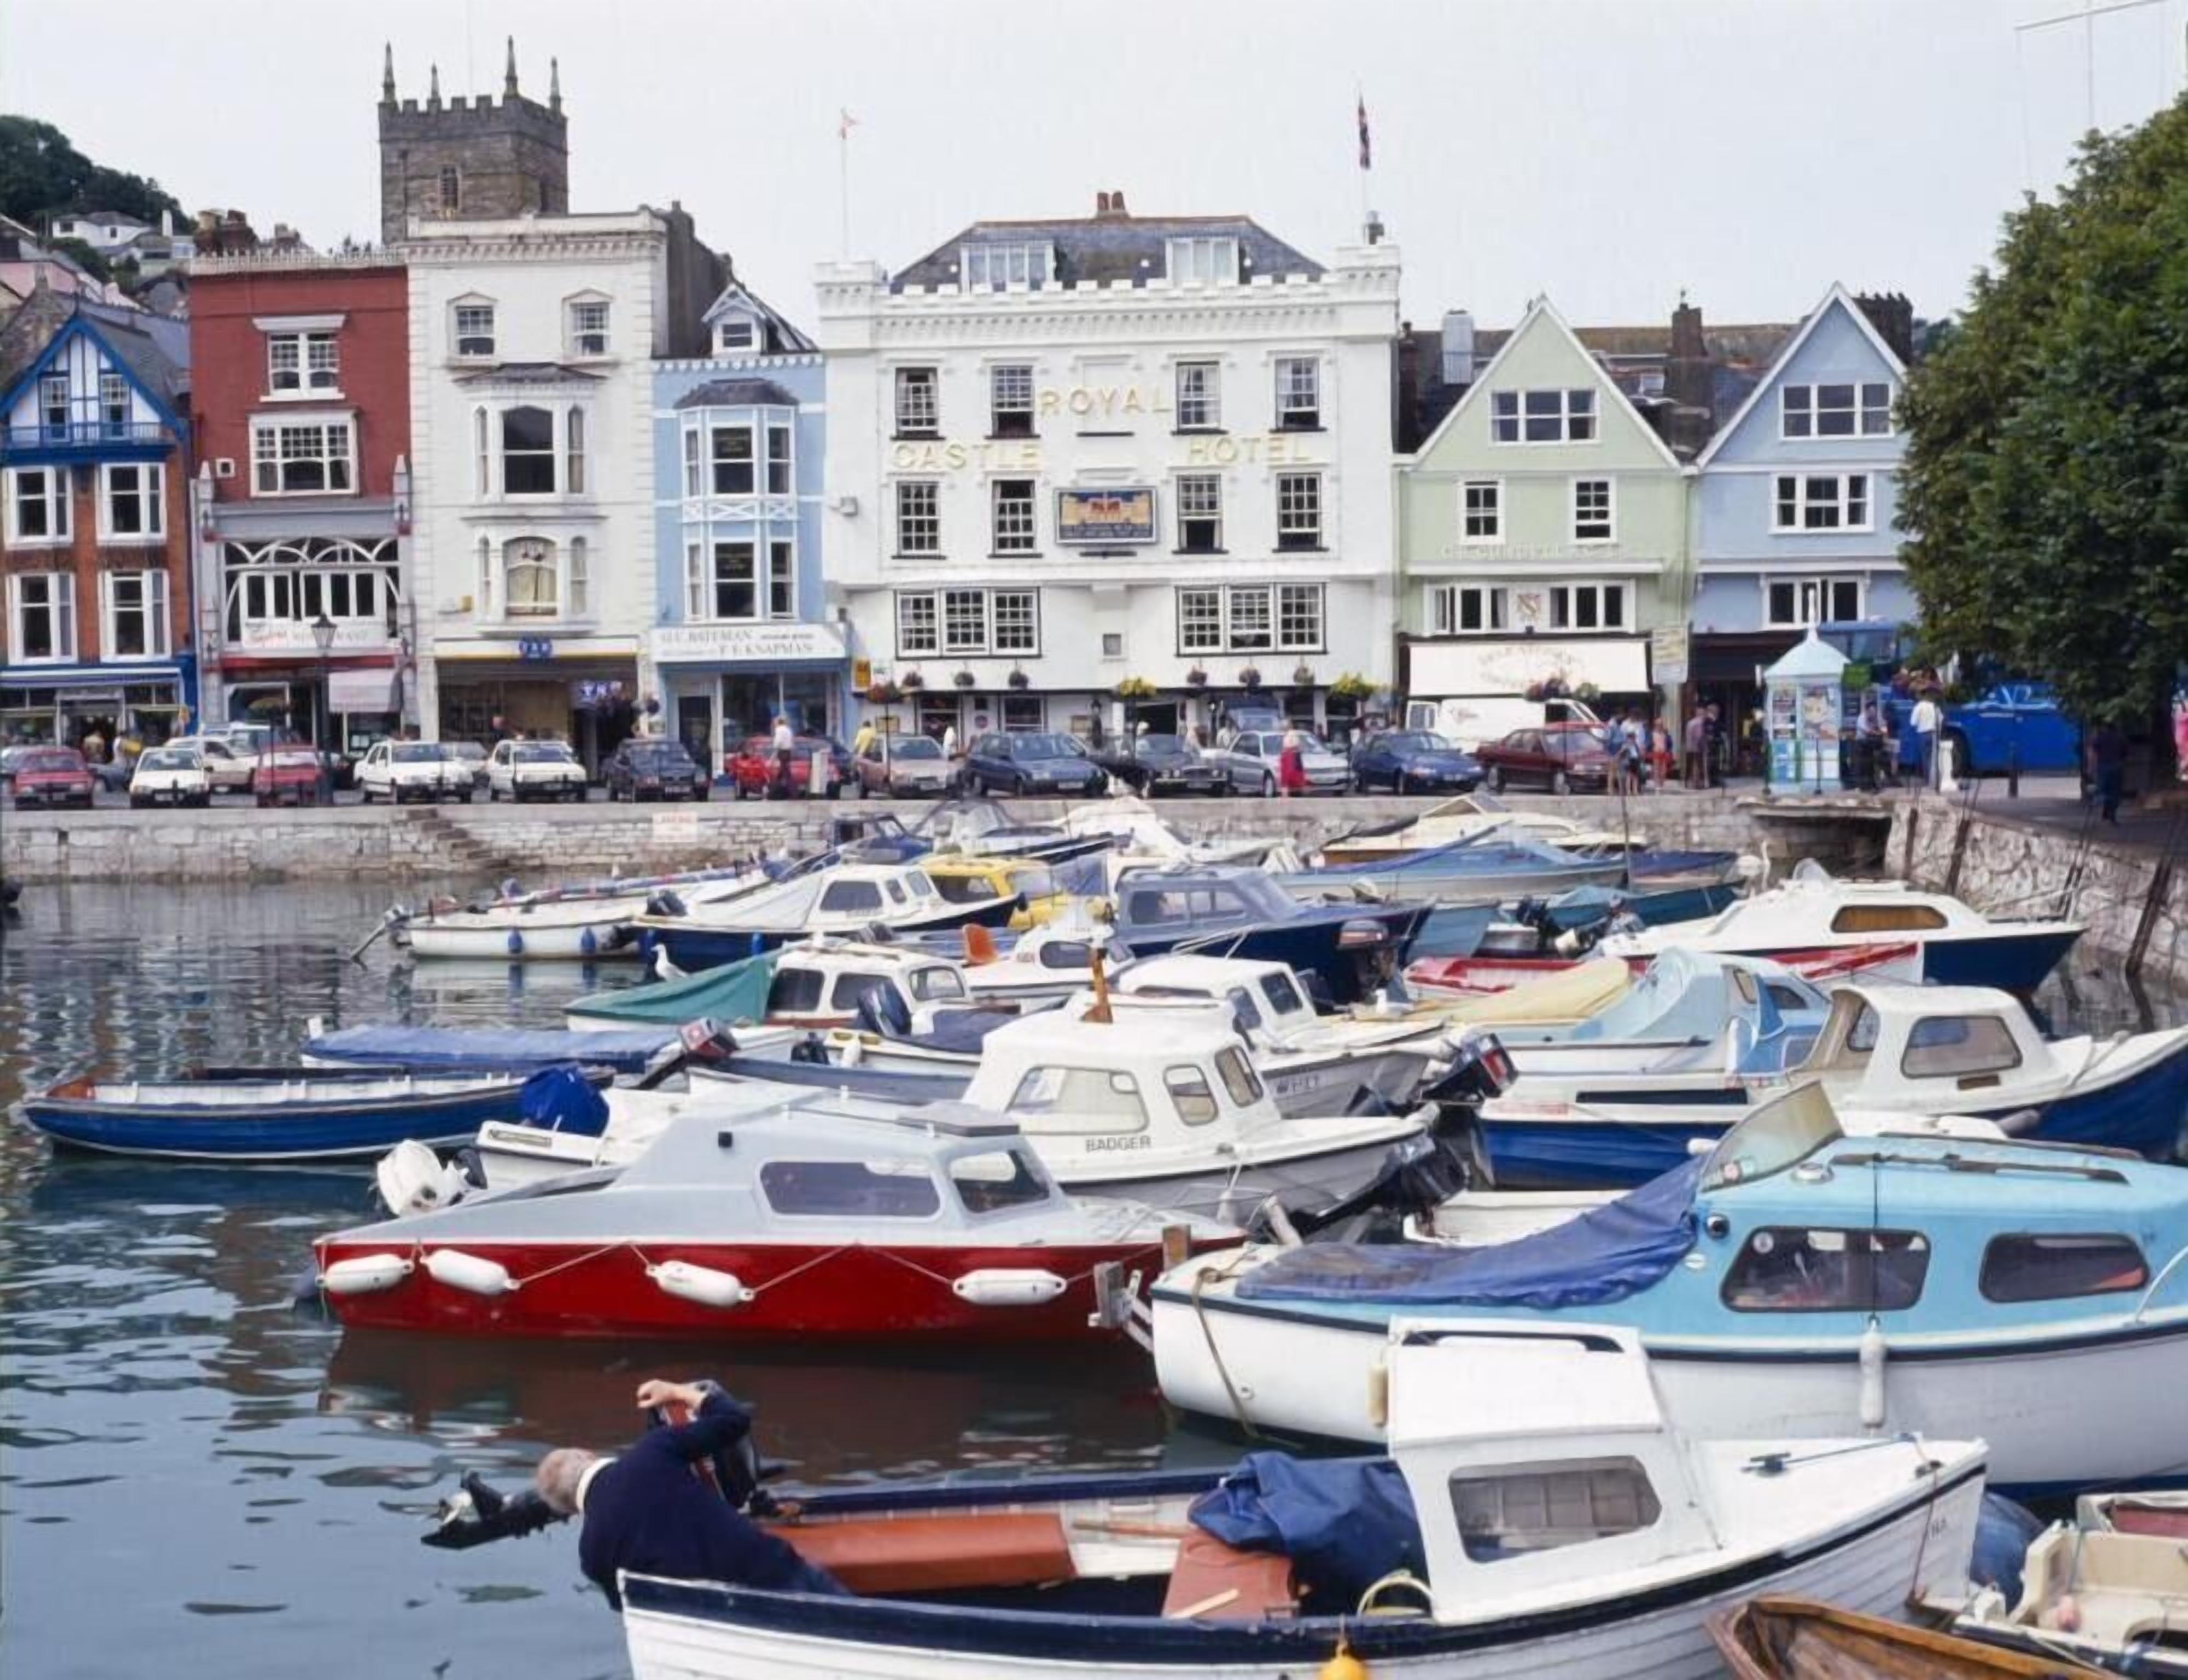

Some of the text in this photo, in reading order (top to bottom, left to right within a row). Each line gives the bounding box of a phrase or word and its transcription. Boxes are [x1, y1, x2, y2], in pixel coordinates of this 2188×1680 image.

[1038, 385, 1174, 417] ROYAL
[893, 436, 1313, 470] CASTLE HOTEL
[1085, 1135, 1151, 1153] BADGER
